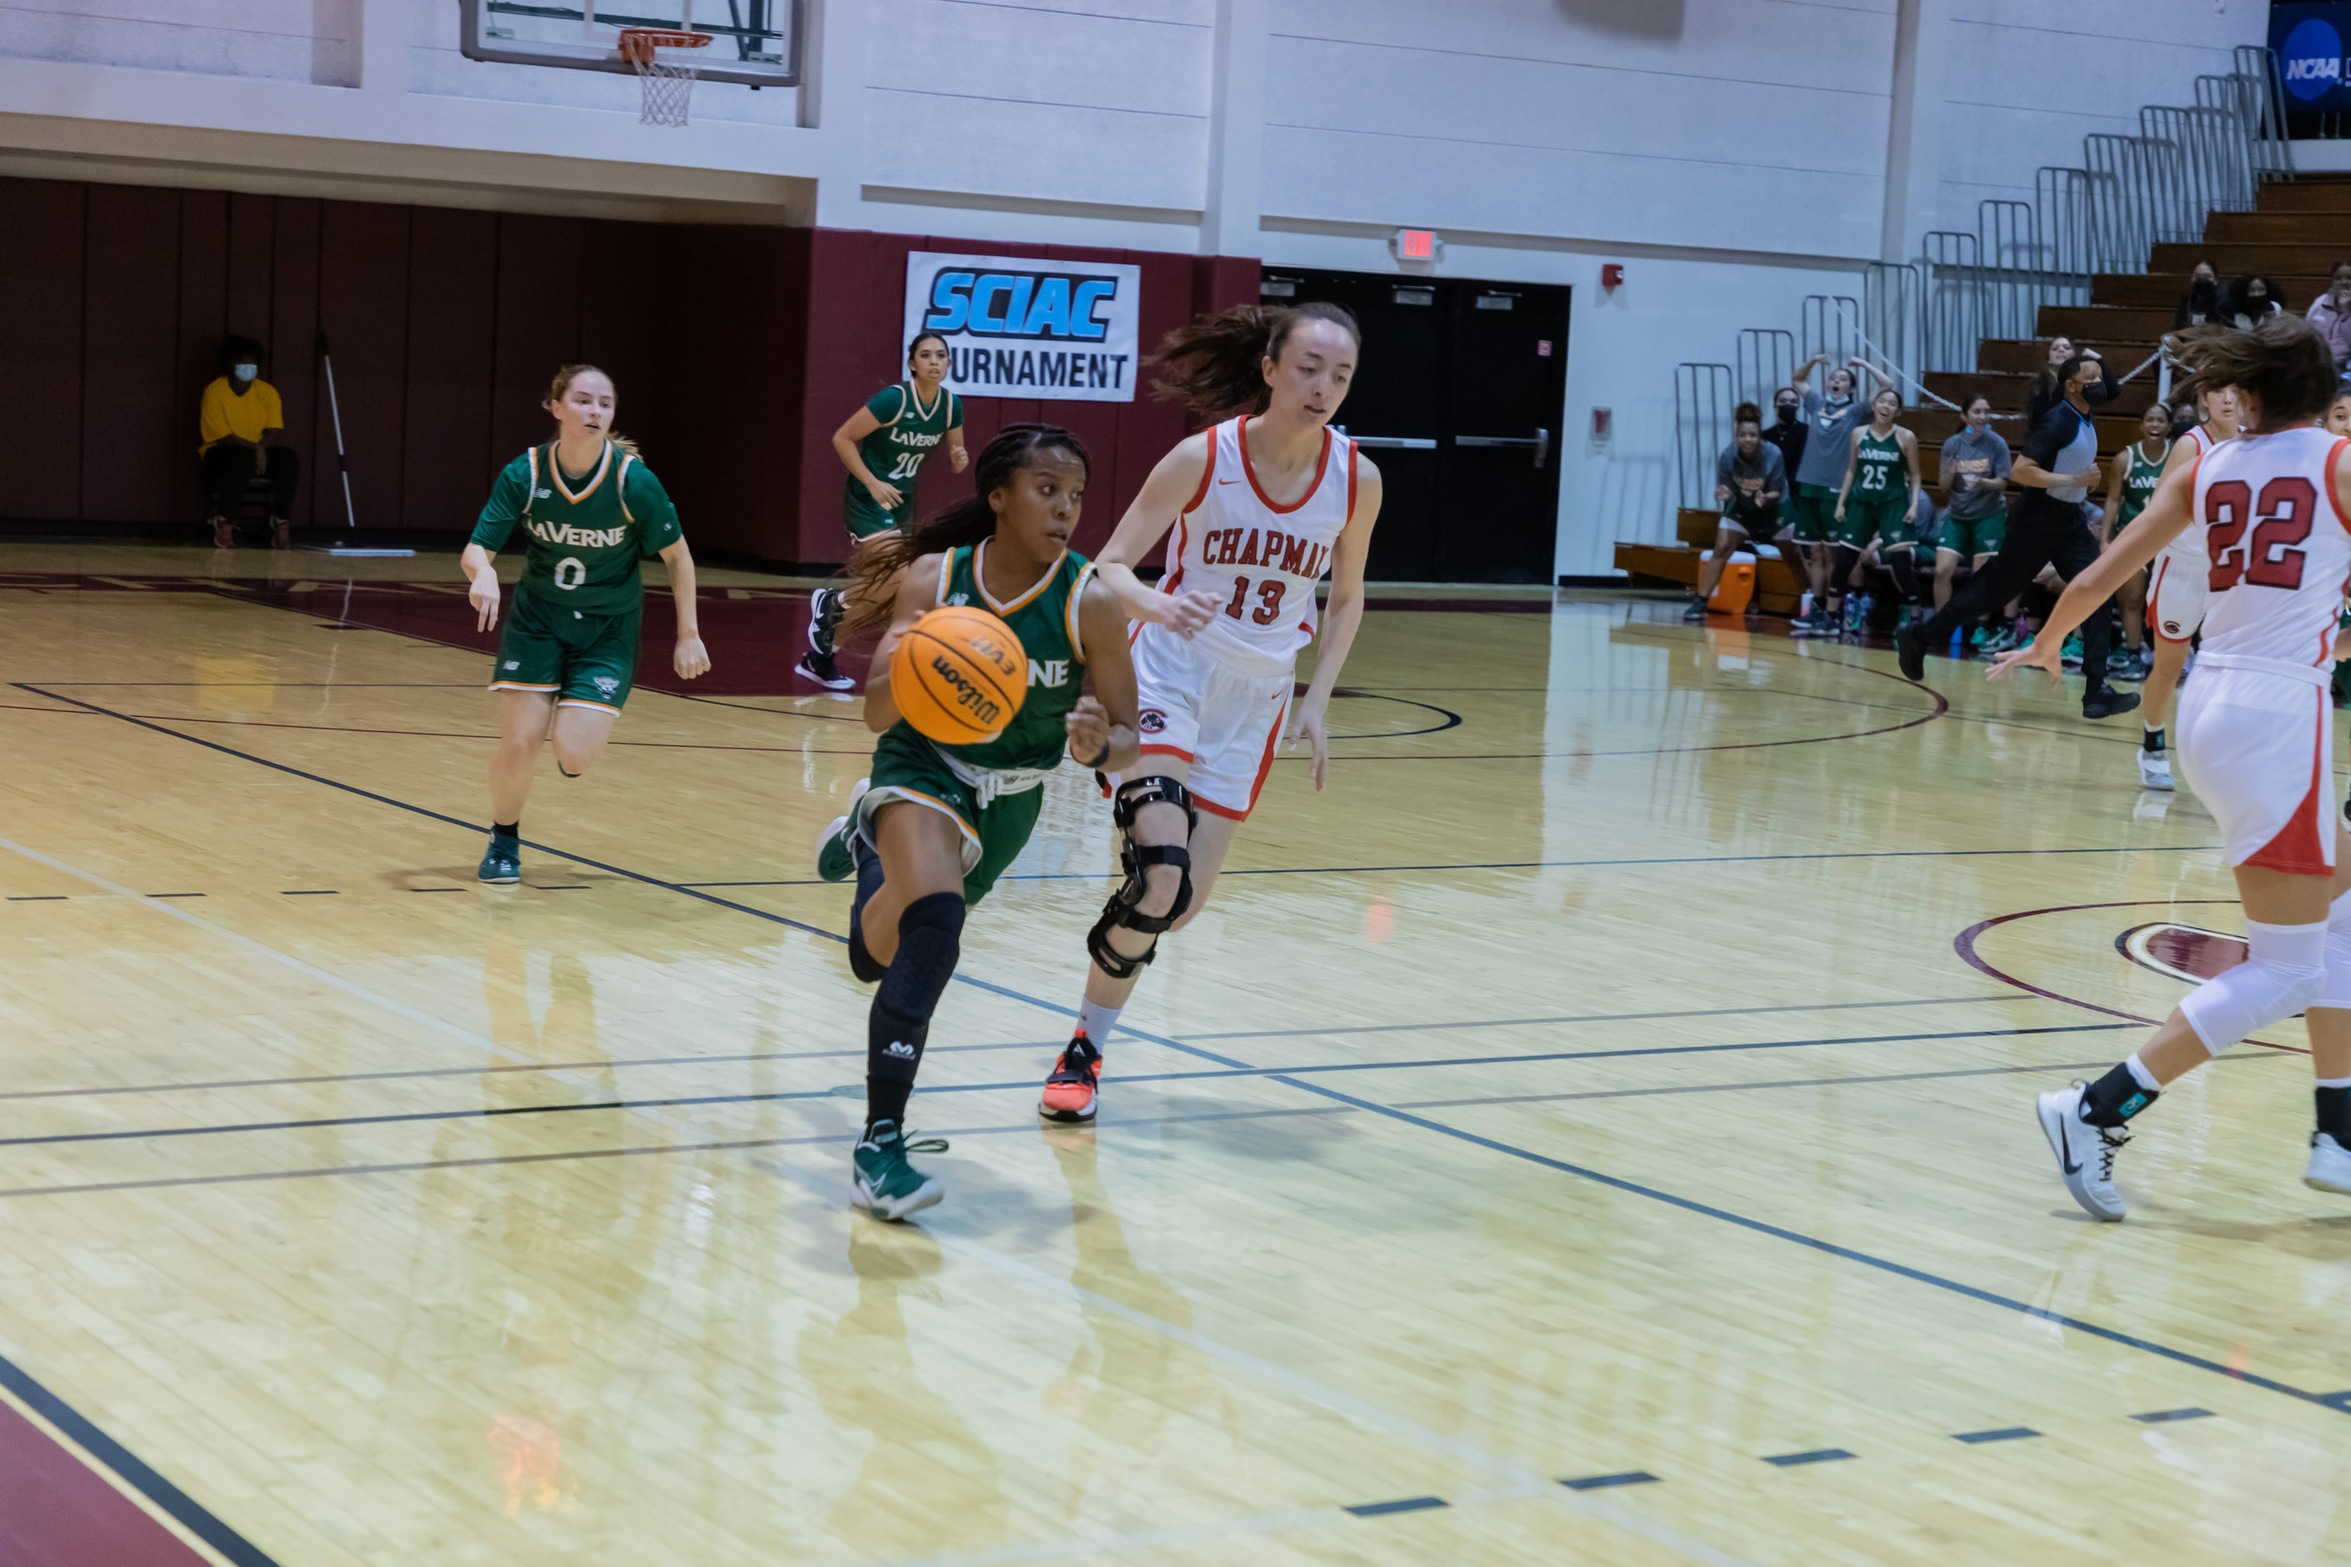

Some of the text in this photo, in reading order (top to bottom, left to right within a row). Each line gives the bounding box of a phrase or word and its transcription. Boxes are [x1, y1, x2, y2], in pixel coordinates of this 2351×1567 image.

[2286, 58, 2340, 80] NCAA
[925, 270, 1117, 340] SCIAC
[949, 346, 1129, 390] URNAMENT
[888, 426, 945, 447] LAVERN
[887, 452, 926, 480] 20
[1861, 464, 1889, 490] 25
[2204, 476, 2319, 593] 22
[554, 556, 586, 591] 0
[1224, 575, 1287, 626] 13
[930, 653, 1001, 726] Wilson
